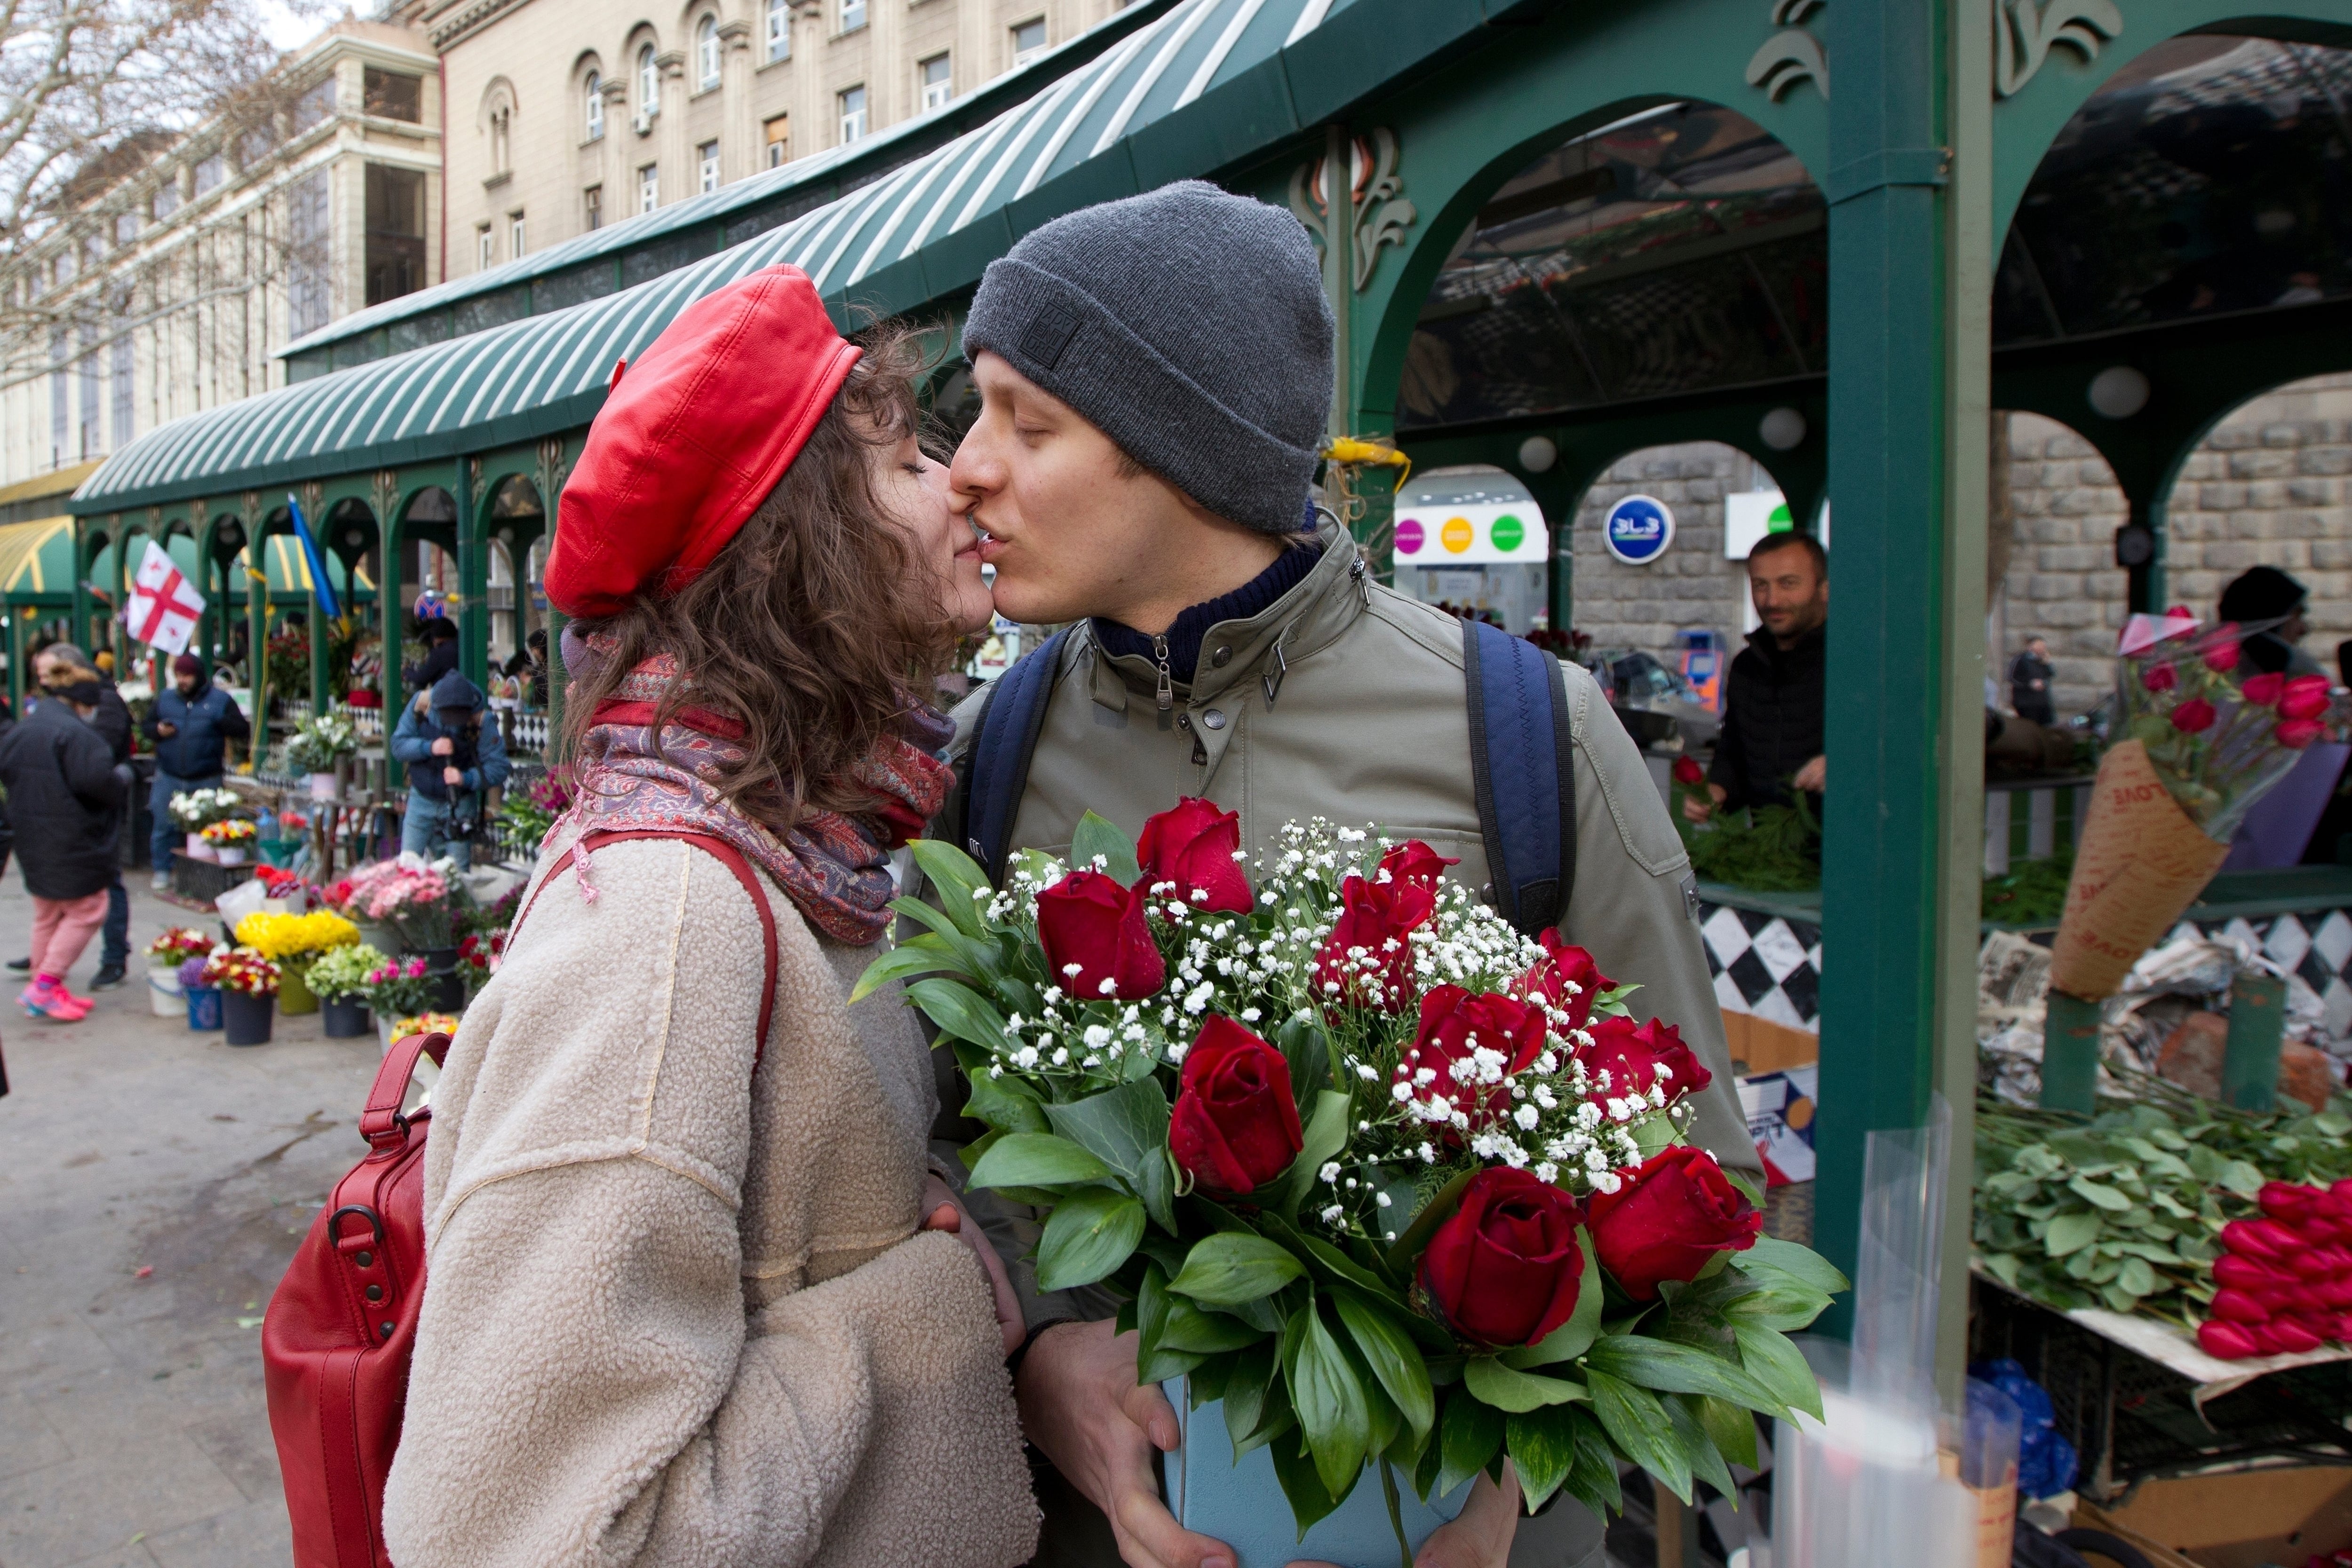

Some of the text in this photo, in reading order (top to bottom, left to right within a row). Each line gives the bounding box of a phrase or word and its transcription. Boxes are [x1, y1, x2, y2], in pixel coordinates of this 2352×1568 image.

[1042, 309, 1074, 331] ADV
[1032, 321, 1065, 346] ENT
[1026, 335, 1055, 359] URE
